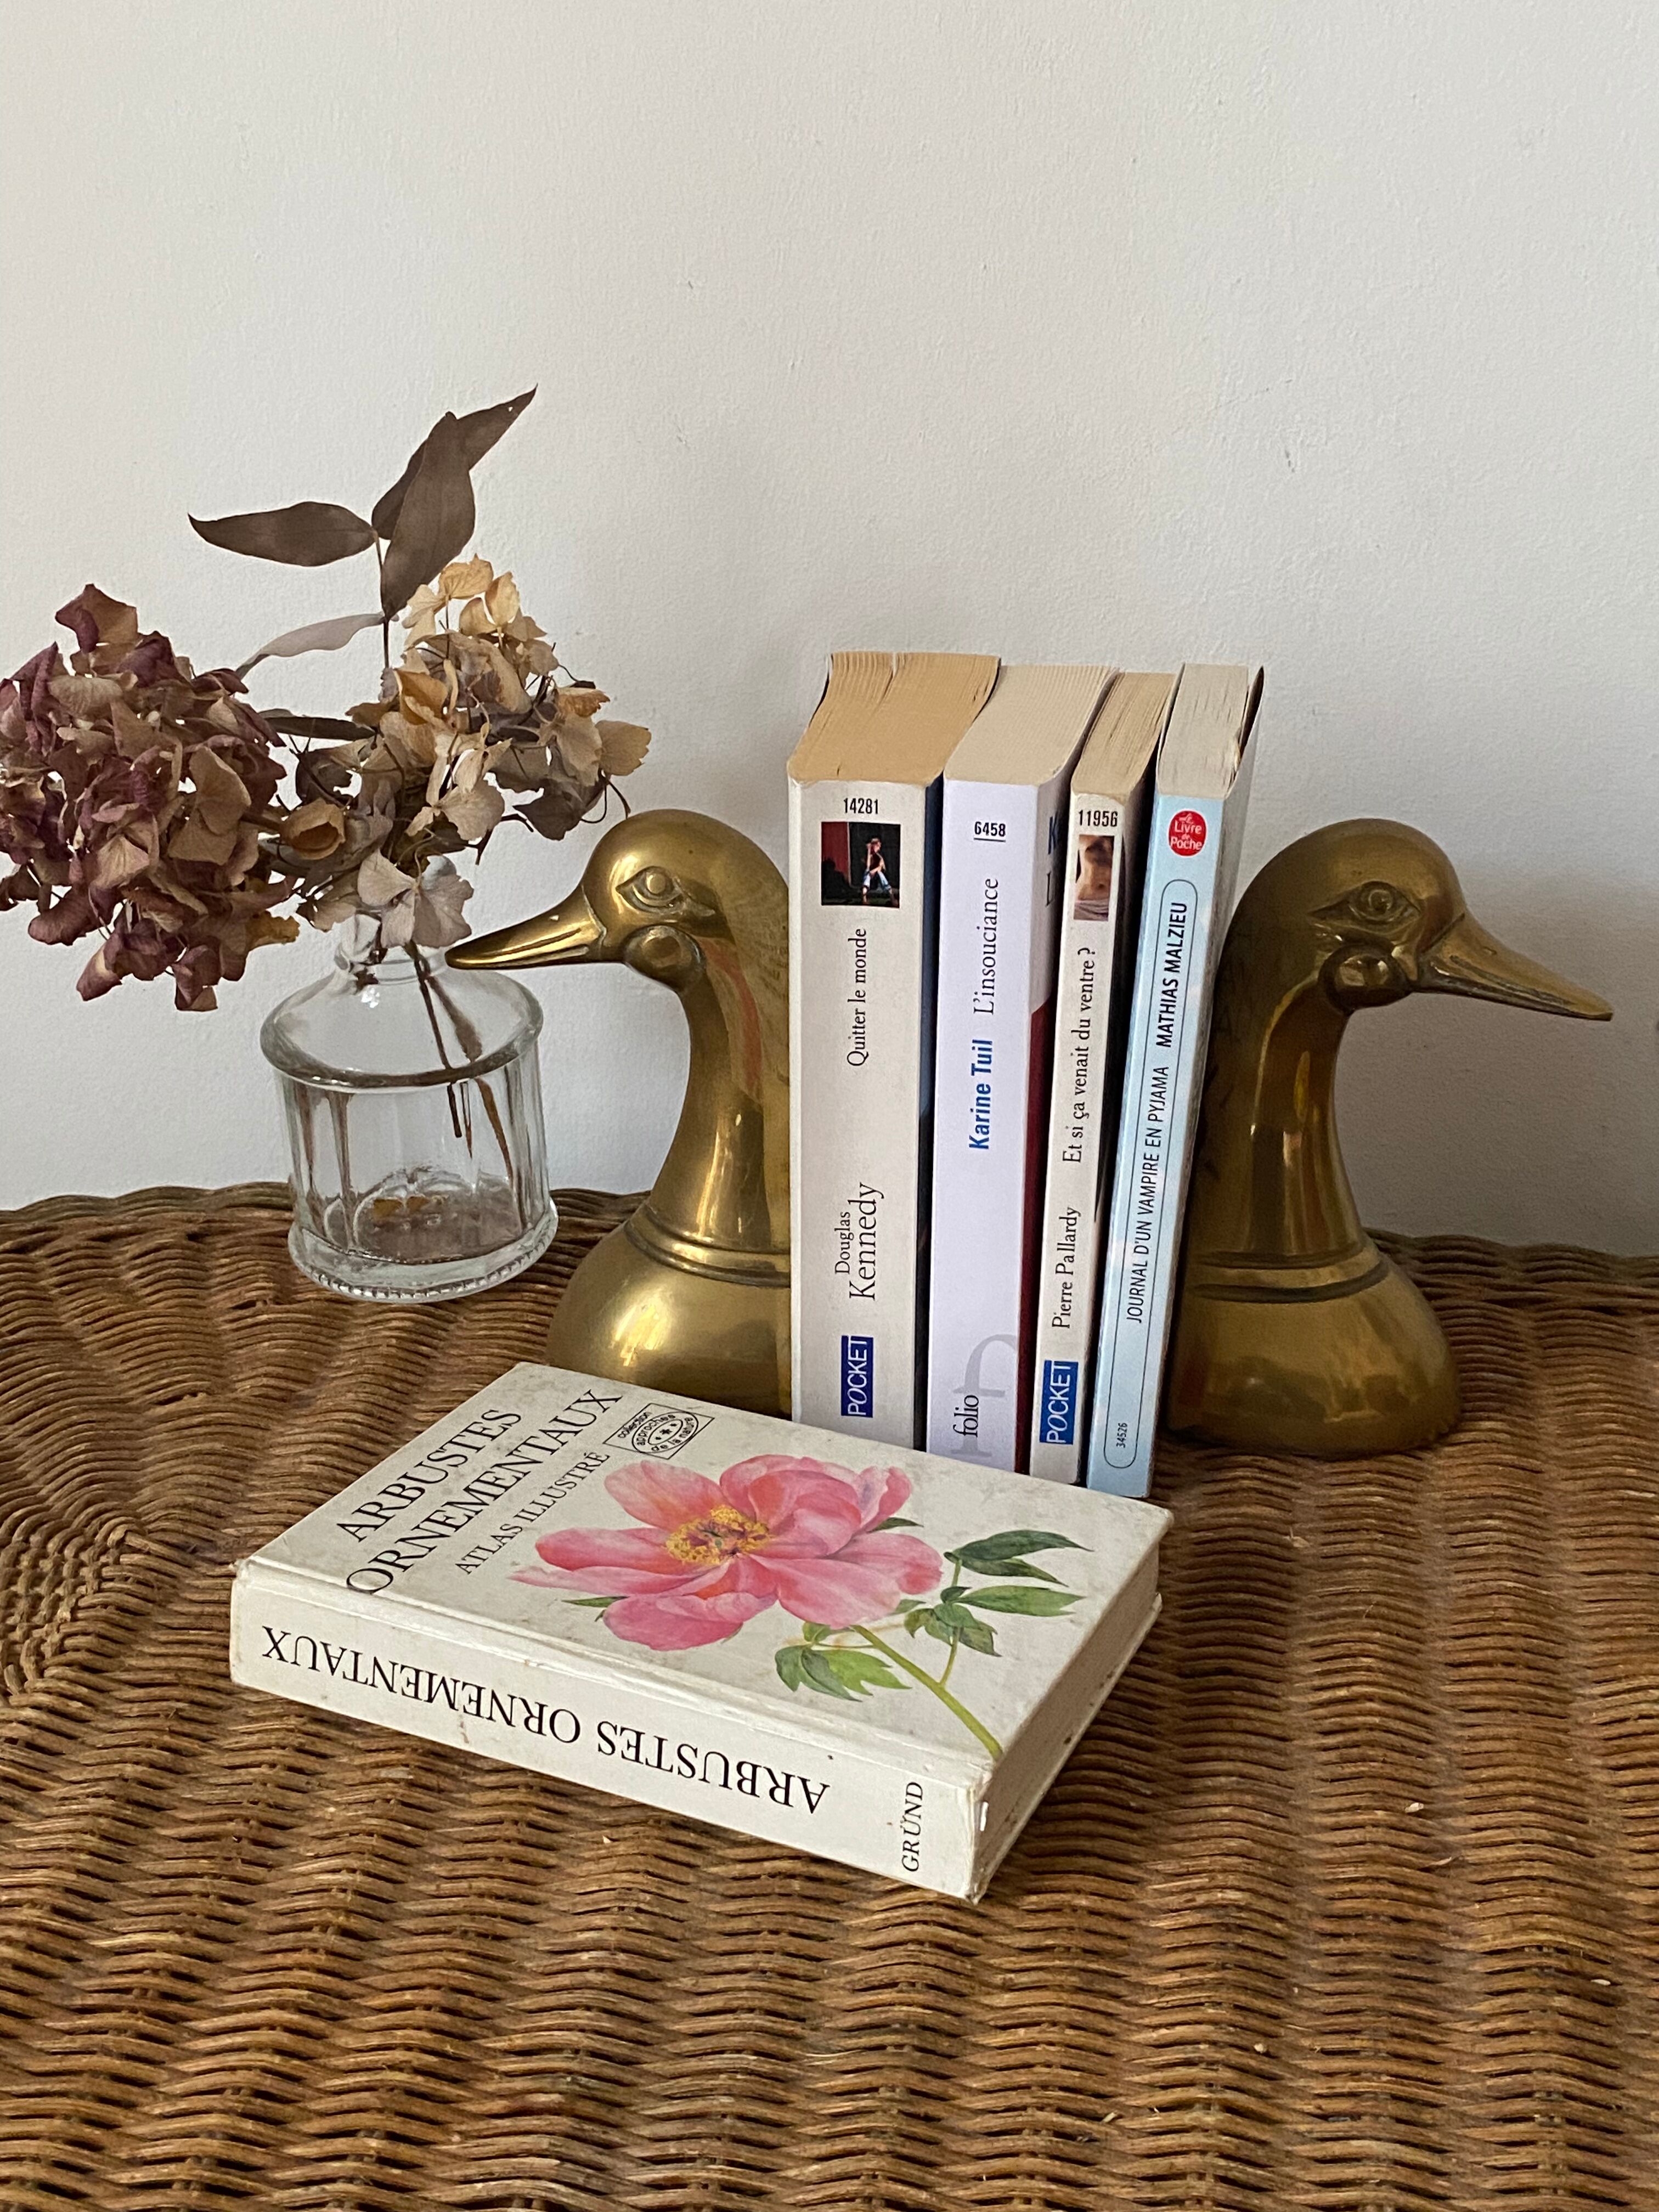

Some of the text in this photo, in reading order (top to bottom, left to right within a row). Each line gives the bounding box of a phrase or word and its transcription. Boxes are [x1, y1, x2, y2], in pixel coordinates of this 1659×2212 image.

[843, 798, 879, 814] 14281
[974, 821, 1006, 837] 6458
[1079, 810, 1118, 827] 11956
[1175, 820, 1202, 834] Livre
[1170, 836, 1202, 850] Poche
[847, 928, 869, 1066] Quitter le monde
[1081, 961, 1094, 1009] ventre
[969, 878, 998, 1150] Karine Tuil L'insouciance
[1071, 1018, 1091, 1039] du
[1070, 1047, 1089, 1096] venait
[1066, 1126, 1084, 1138] si
[1073, 1102, 1089, 1119] ça
[1126, 902, 1187, 1323] JOURNAL D'UN VAMPIRE EN PYJAMA MATHIAS MALZIEU
[1063, 1144, 1082, 1163] Et
[834, 1211, 854, 1274] Douglas
[849, 1182, 885, 1300] Kennedy
[1051, 1207, 1082, 1329] Pierre Pallardy
[848, 1335, 868, 1416] POCKET
[617, 1412, 653, 1438] collection
[952, 1395, 979, 1438] folio
[1046, 1361, 1071, 1444] POCKET
[636, 1414, 676, 1446] approches
[1116, 1423, 1128, 1448] 34526
[336, 1408, 522, 1543] ARBUSTES
[346, 1389, 623, 1594] ORNEMENTAUX
[455, 1450, 611, 1575] ATLAS ILLUSTRÉ
[261, 1626, 831, 1815] ARBUSTES ORNEMENTAUX
[900, 1782, 923, 1872] GRÜND
